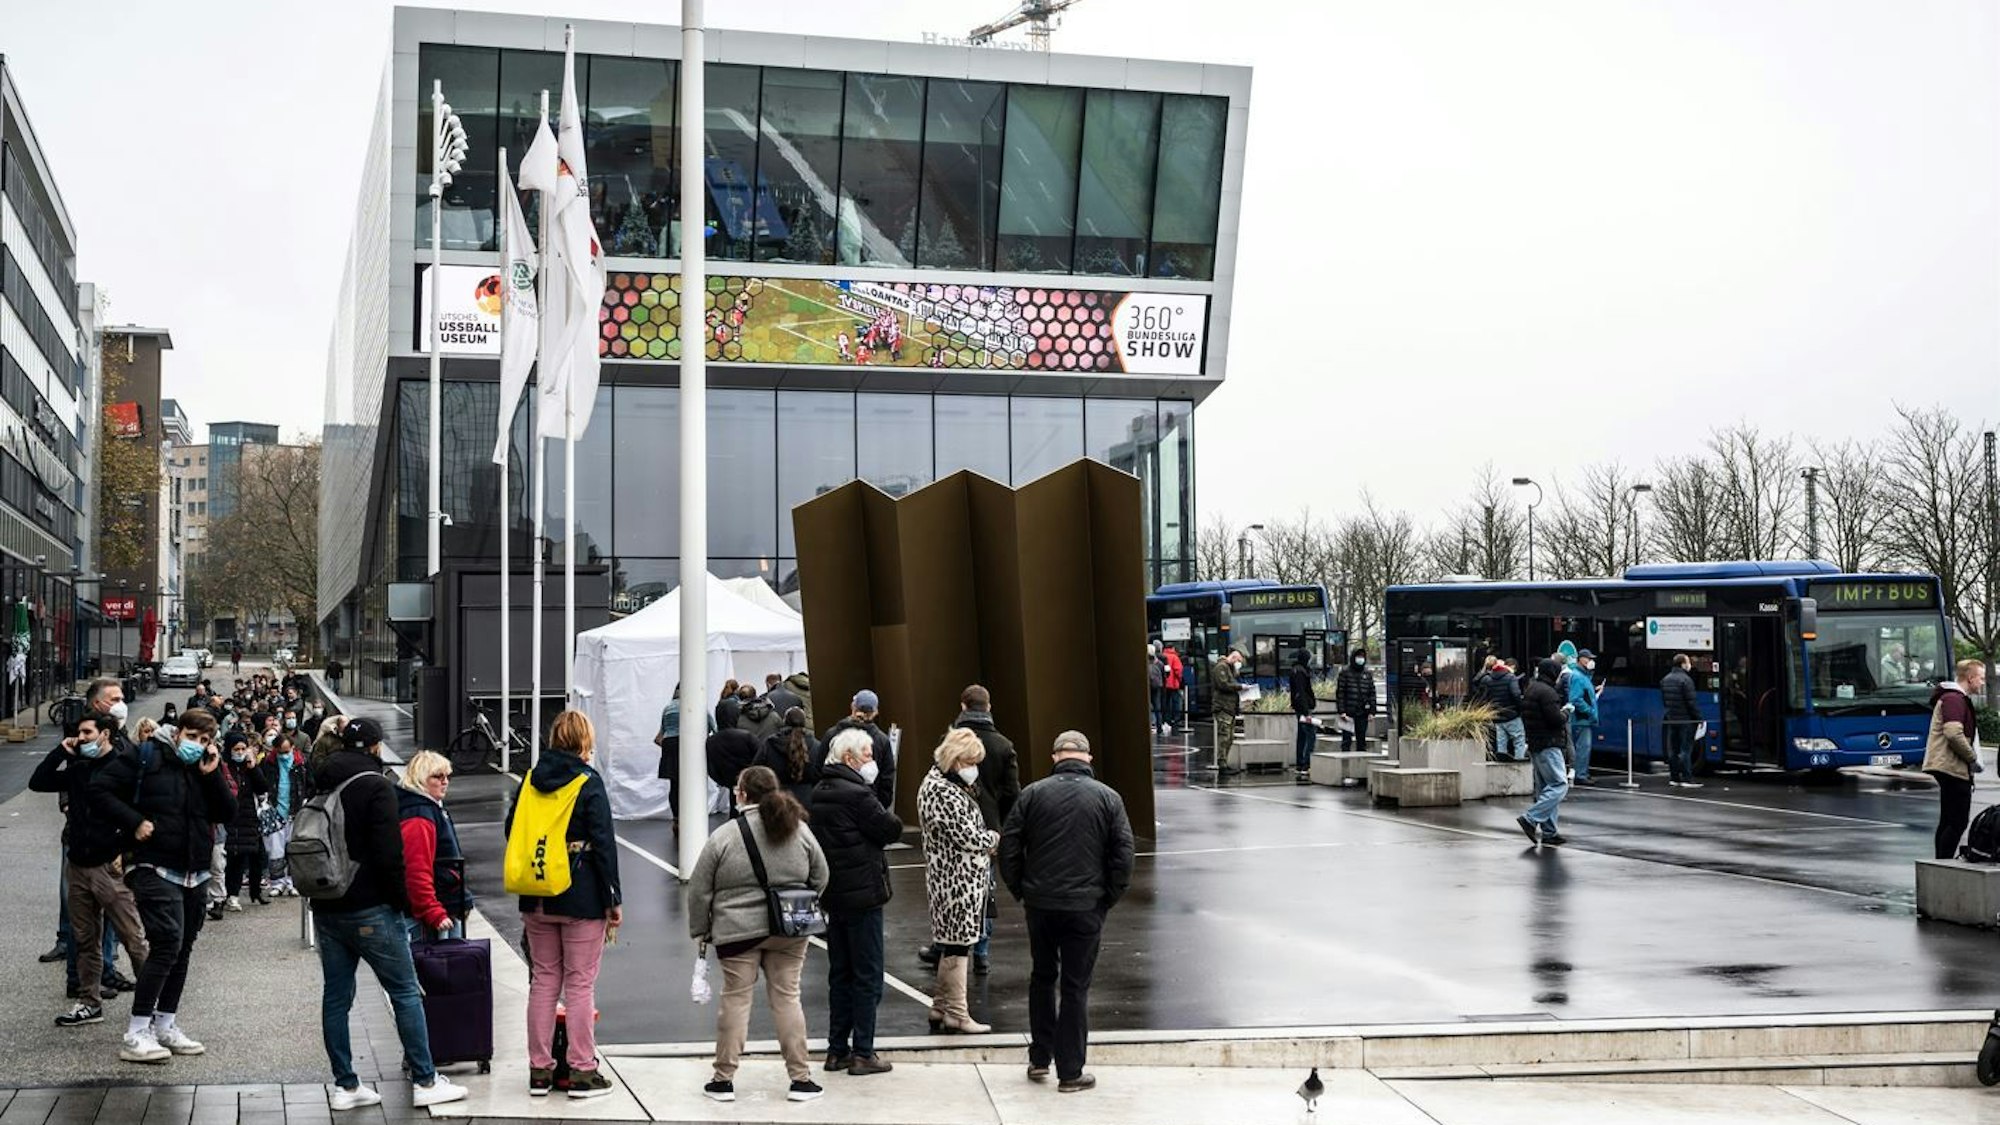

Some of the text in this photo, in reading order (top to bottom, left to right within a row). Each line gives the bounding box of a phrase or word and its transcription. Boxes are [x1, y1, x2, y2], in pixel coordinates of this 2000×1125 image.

[440, 313, 479, 321] UTSCHES
[1129, 305, 1184, 331] 360°
[439, 321, 499, 333] USSBALL
[440, 333, 487, 344] USEUM
[1127, 330, 1197, 342] BUNDESLIGA
[1126, 340, 1195, 359] SHOW
[1250, 591, 1317, 606] IMPFBUS
[1836, 583, 1929, 602] IMPFBUS
